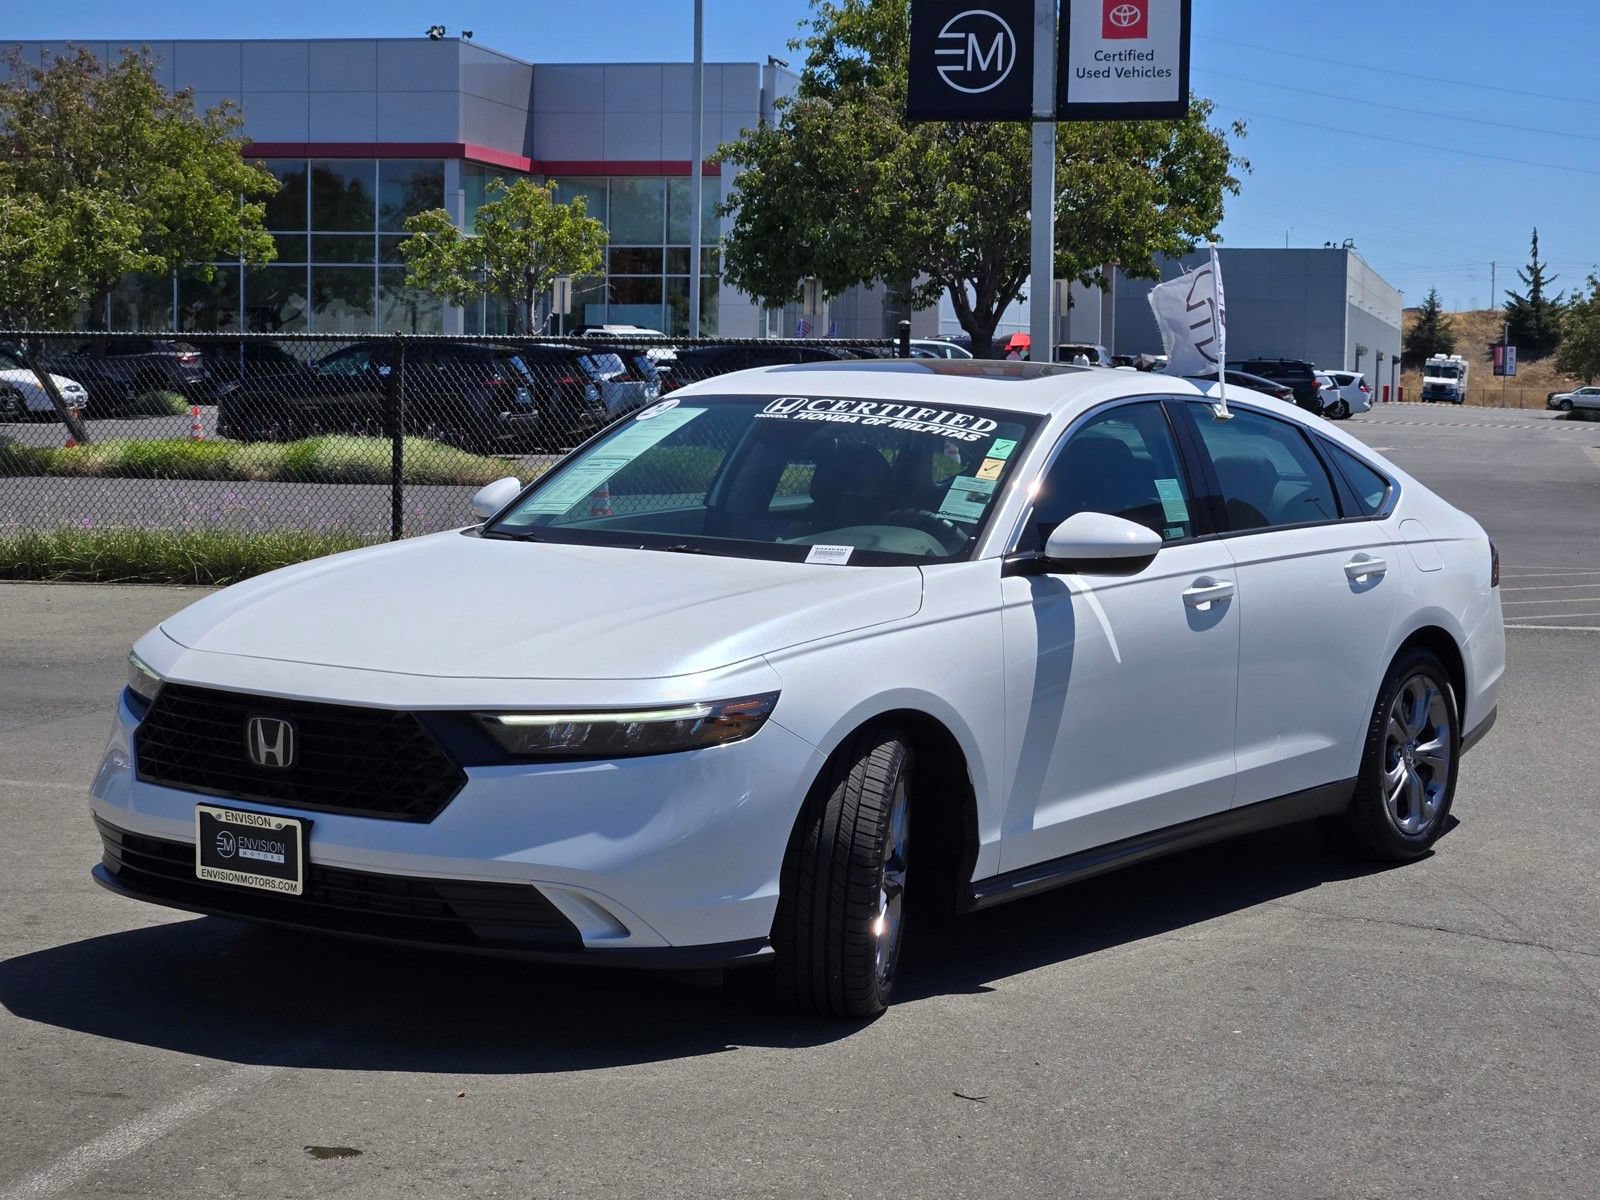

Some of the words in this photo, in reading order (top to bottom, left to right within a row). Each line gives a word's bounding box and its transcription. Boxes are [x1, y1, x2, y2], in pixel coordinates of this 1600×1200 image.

[1094, 49, 1155, 62] Certified
[1076, 66, 1111, 79] Used
[1114, 65, 1172, 78] Vehicles
[806, 398, 998, 433] CERTIFIED
[793, 411, 857, 424] HONDA
[861, 416, 890, 426] OF
[889, 419, 982, 442] MILPITAS
[224, 811, 272, 828] ENVISION
[238, 836, 285, 854] ENVISION
[242, 851, 281, 861] MOTORS
[201, 868, 298, 893] ENVISIONMOTORS.COM
